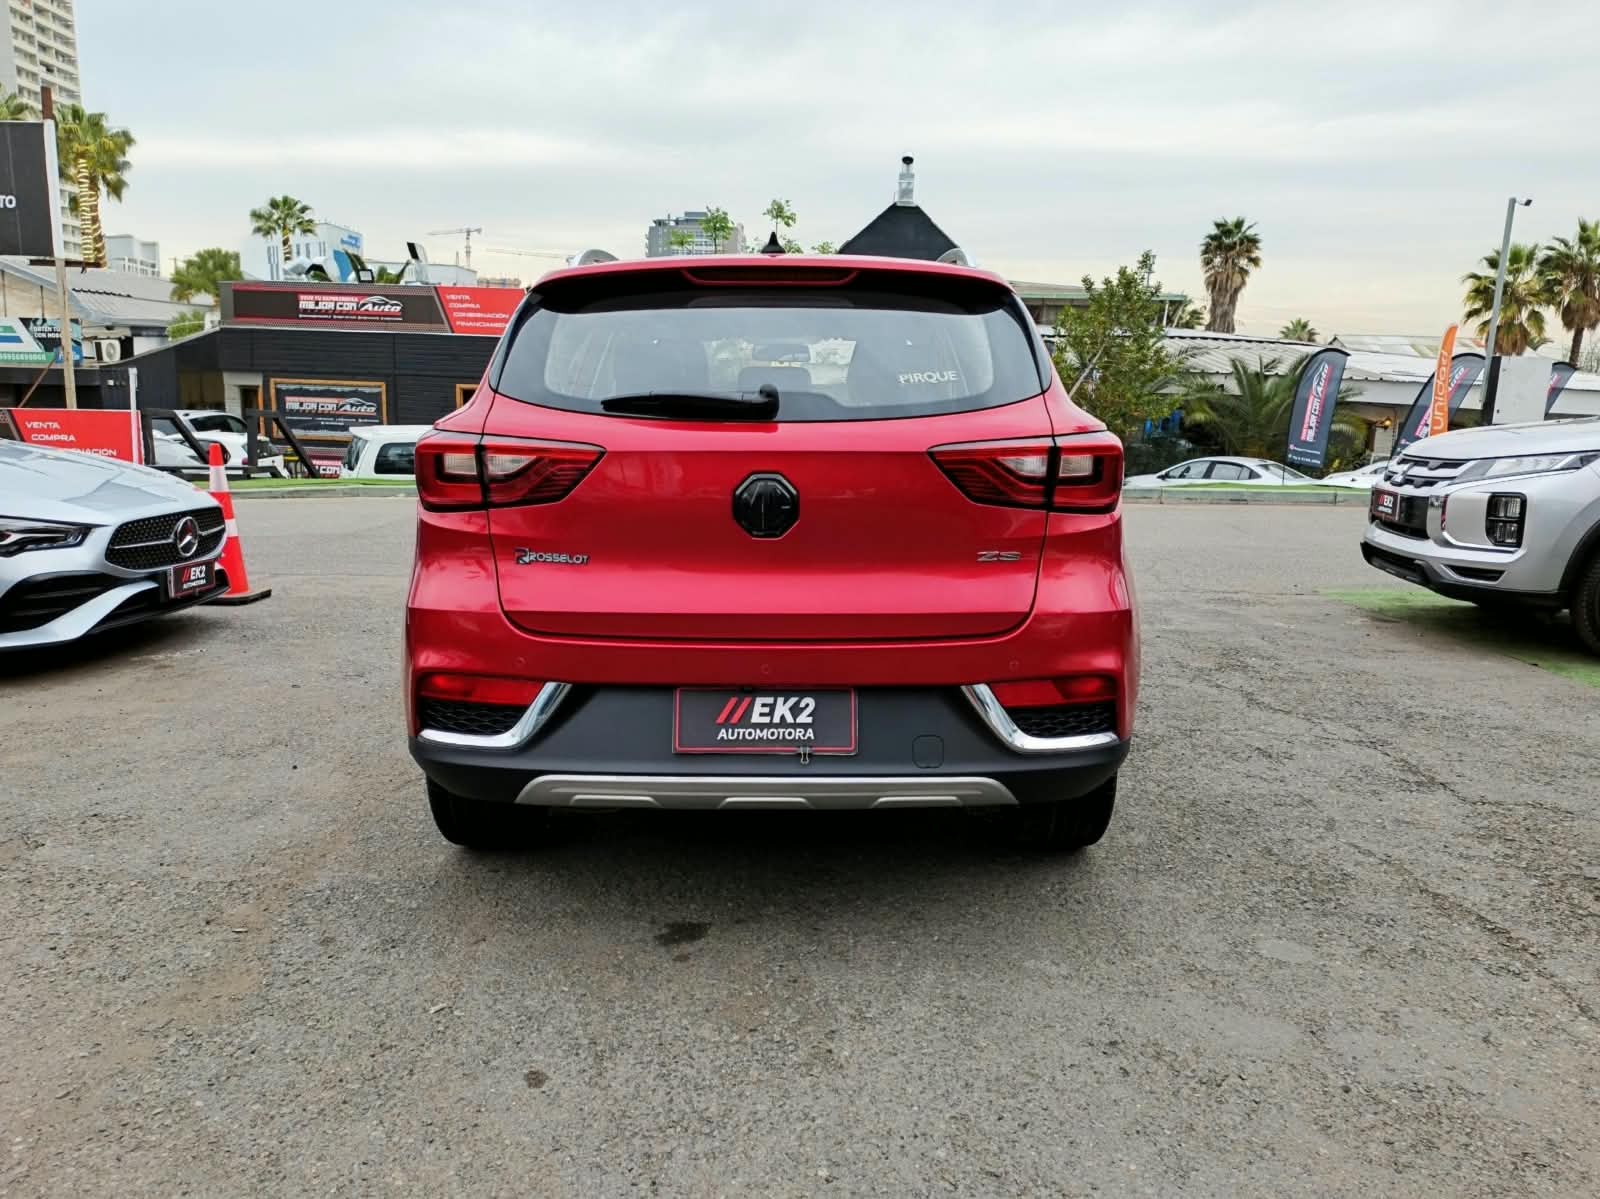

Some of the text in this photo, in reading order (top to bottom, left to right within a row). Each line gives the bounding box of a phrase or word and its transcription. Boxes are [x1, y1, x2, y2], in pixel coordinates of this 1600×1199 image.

[336, 302, 357, 311] CON
[360, 303, 402, 313] Auto
[898, 371, 959, 384] PIRQUE
[339, 404, 376, 412] Auto
[25, 421, 60, 429] VENTA
[31, 433, 76, 441] COMPRA
[528, 551, 589, 564] ROSSELOT
[976, 550, 1021, 561] ZS
[717, 728, 815, 740] AUTOMOTORA
